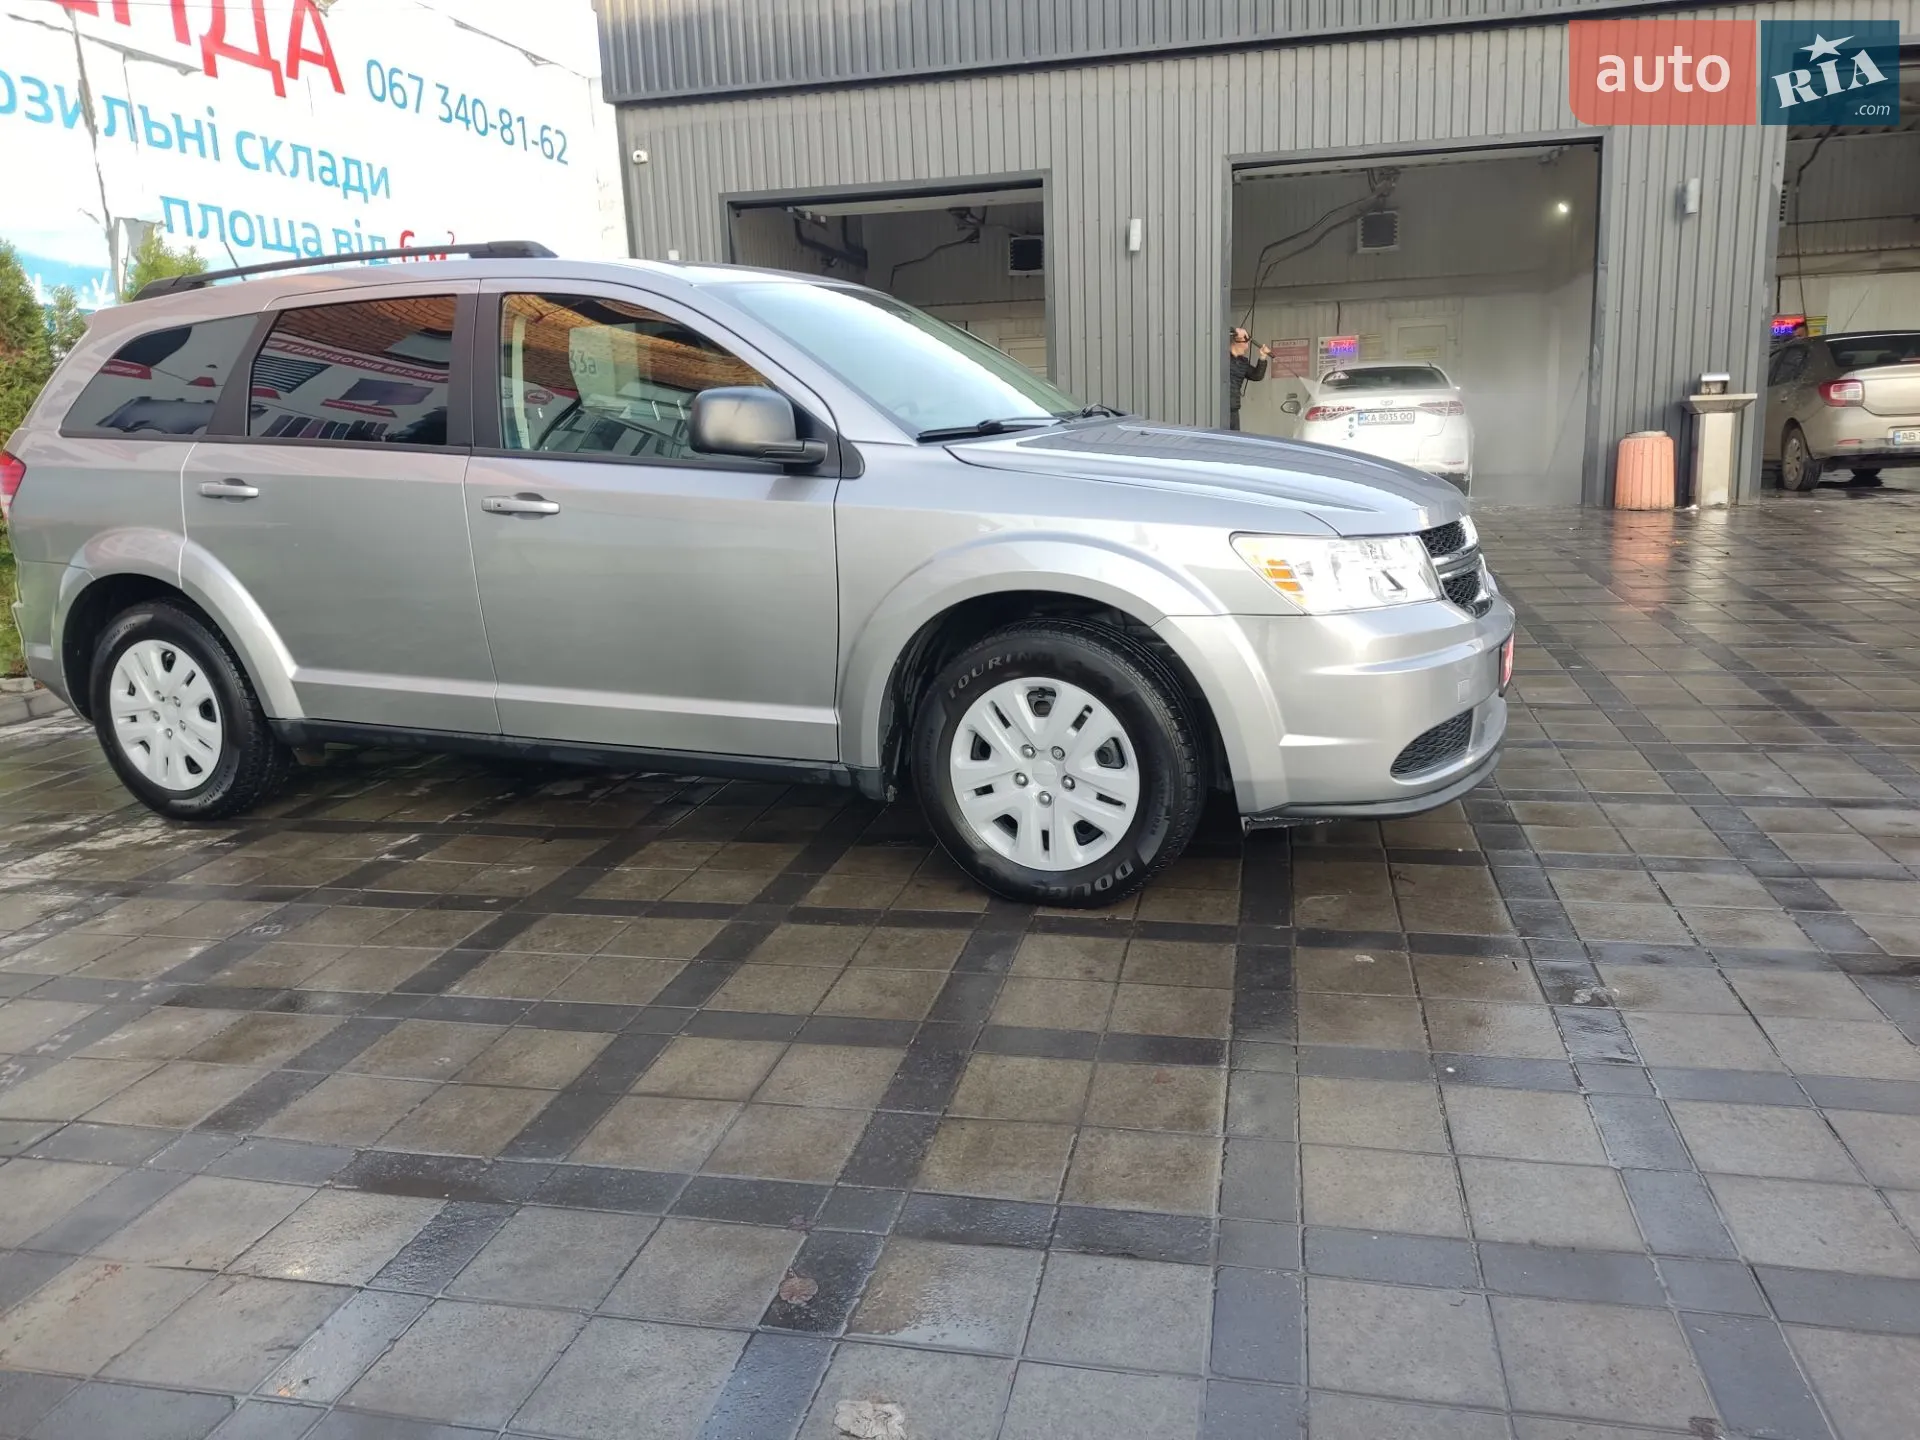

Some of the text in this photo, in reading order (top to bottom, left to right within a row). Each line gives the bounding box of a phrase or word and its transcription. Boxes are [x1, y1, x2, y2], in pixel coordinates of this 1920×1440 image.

[366, 59, 569, 165] 067 340-81-62
[235, 130, 391, 203] склади
[160, 195, 325, 262] площа
